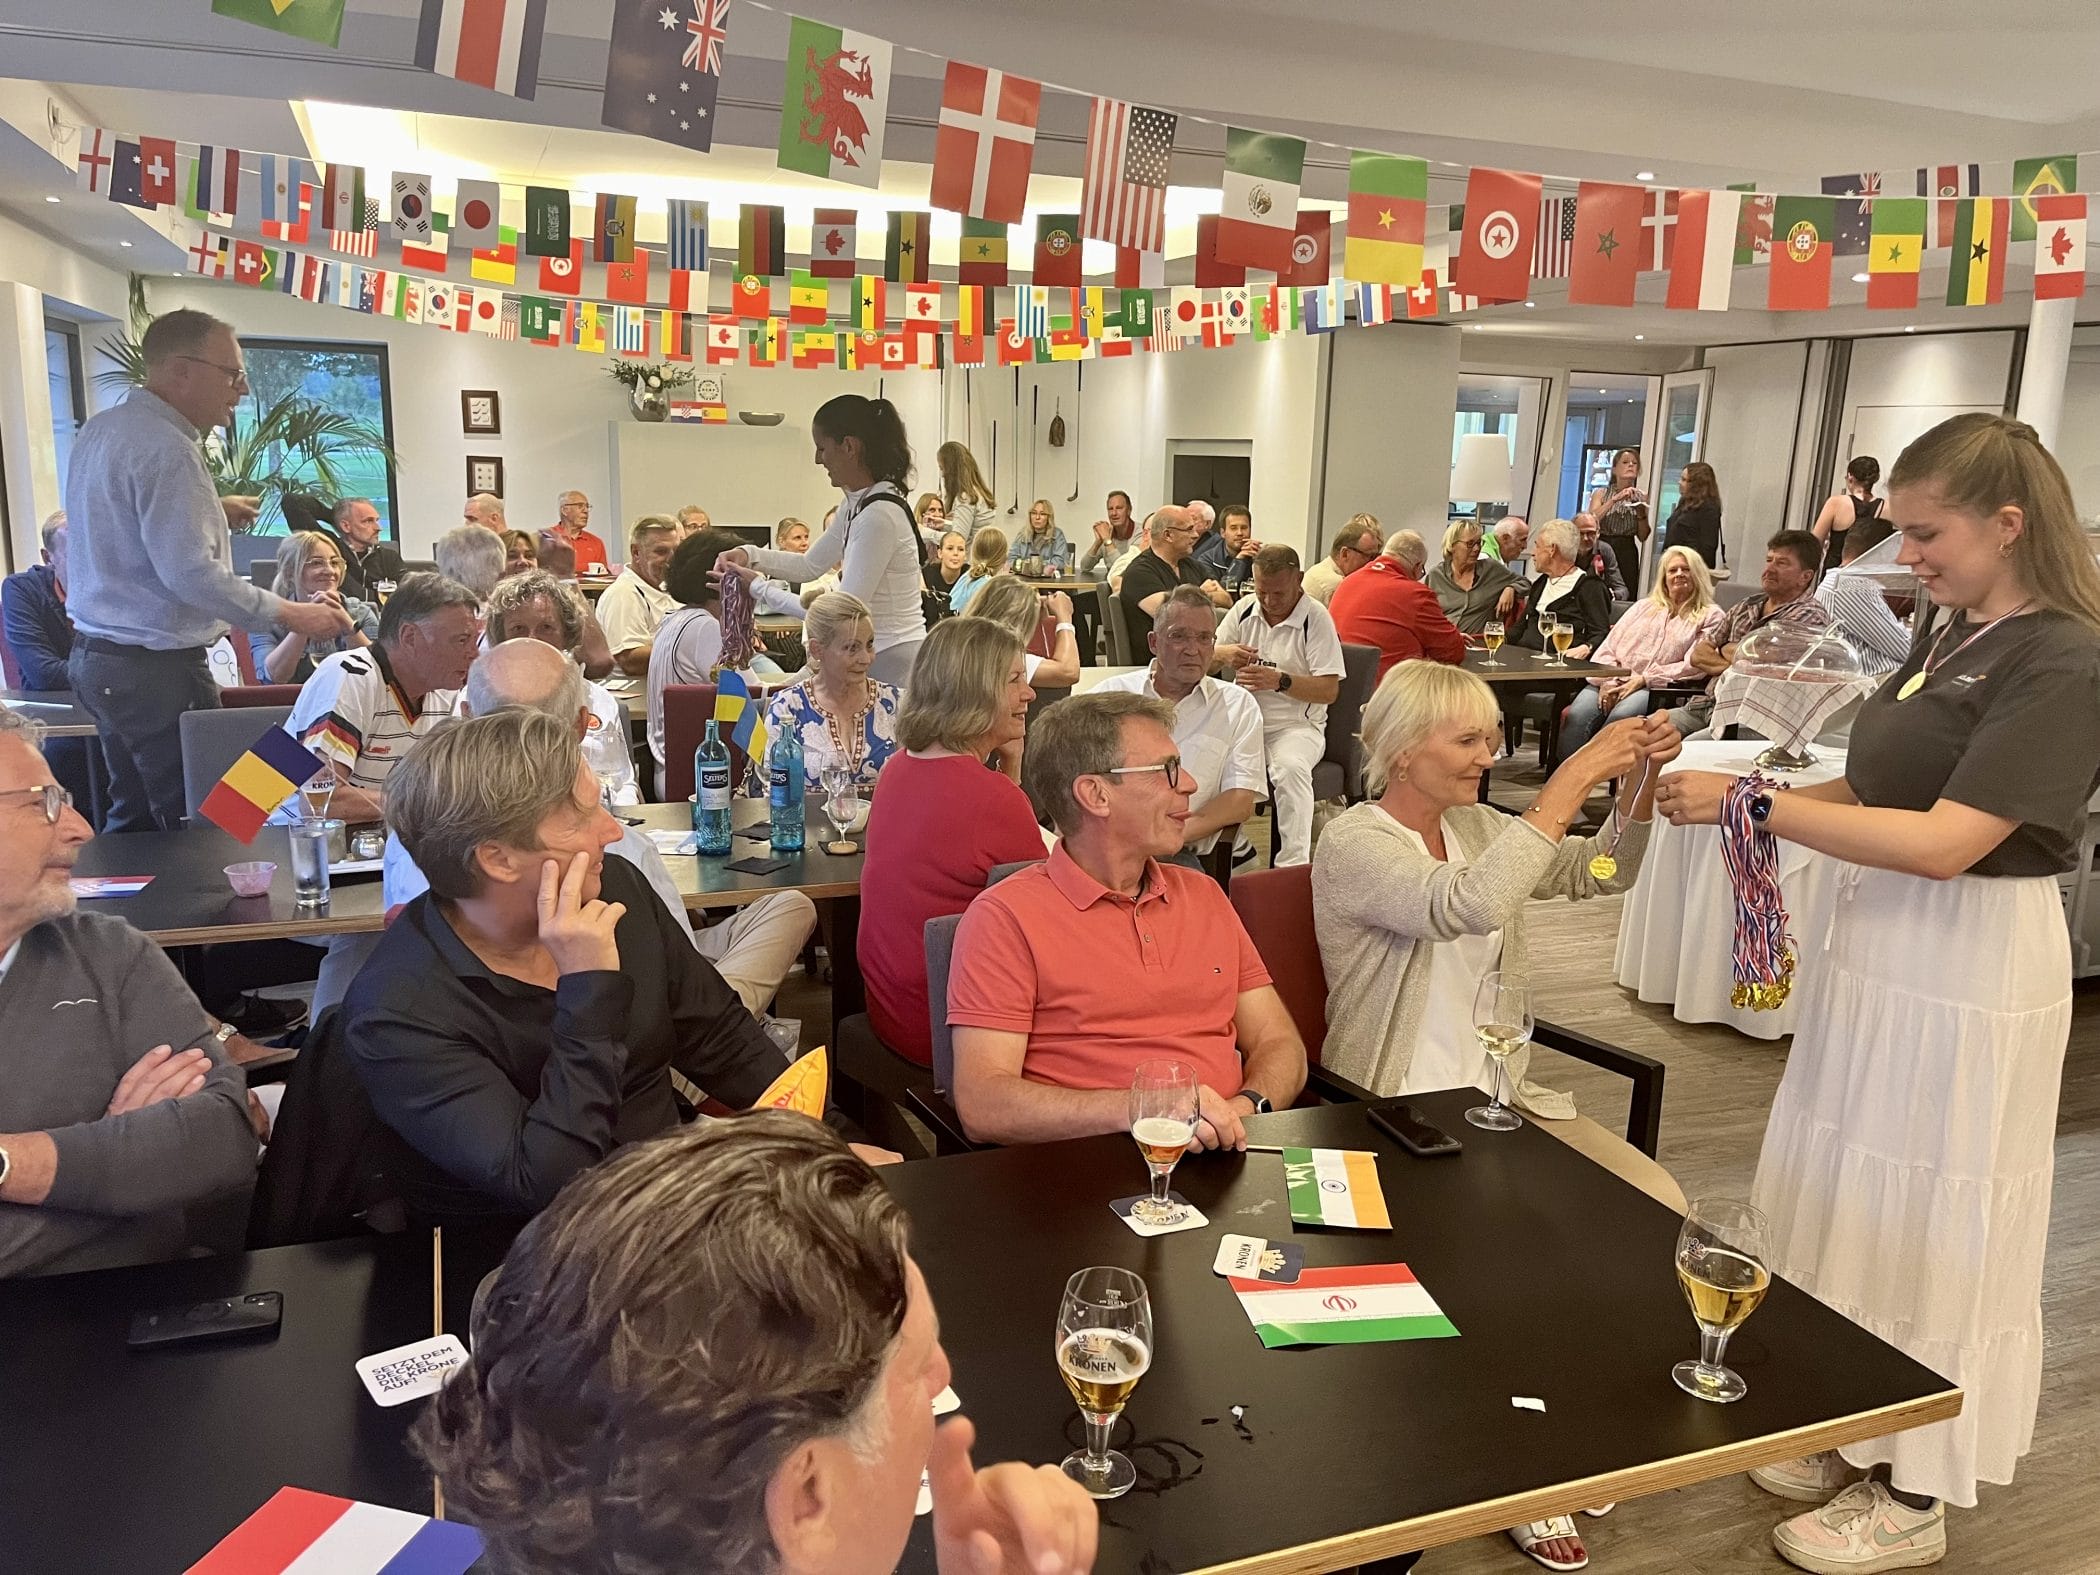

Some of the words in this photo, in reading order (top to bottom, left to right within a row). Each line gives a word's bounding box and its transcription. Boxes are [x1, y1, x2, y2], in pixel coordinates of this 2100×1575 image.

[1234, 1243, 1252, 1270] KRONEN
[371, 1357, 416, 1375] SETZT
[421, 1346, 453, 1360] DEM
[375, 1360, 434, 1381] DECKEL
[379, 1374, 404, 1387] DIE
[408, 1357, 460, 1379] KRONE
[1069, 1353, 1116, 1372] KRONEN
[383, 1377, 418, 1392] AUF!
